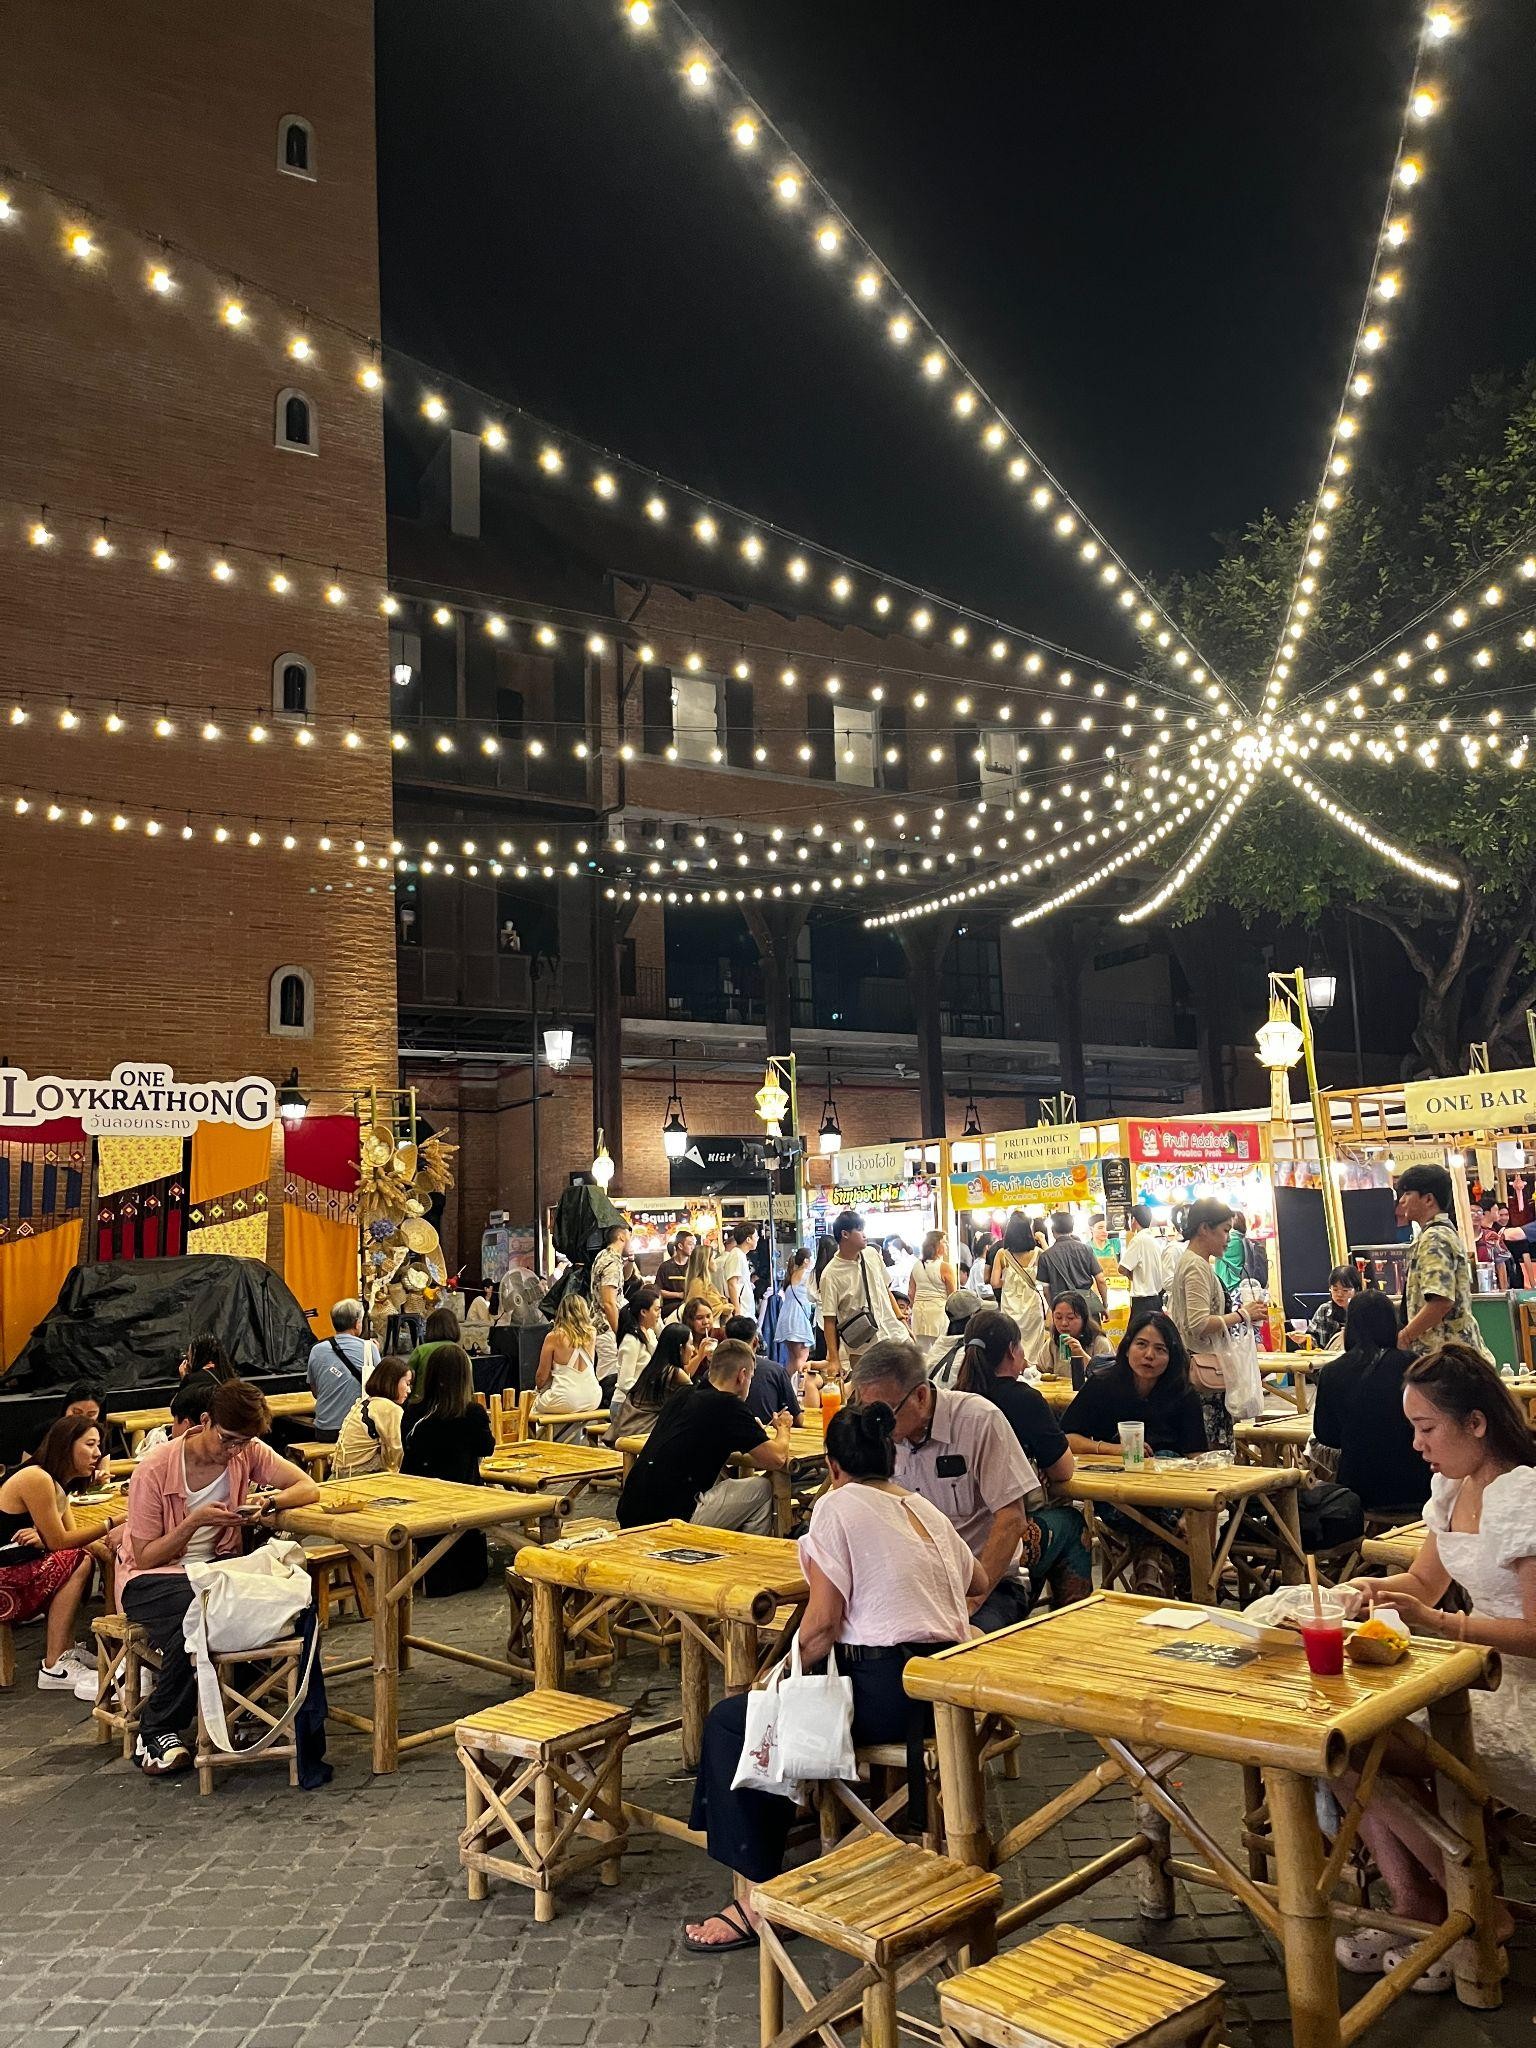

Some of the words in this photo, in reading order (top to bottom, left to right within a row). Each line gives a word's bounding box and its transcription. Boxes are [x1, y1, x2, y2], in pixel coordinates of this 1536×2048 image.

[120, 1070, 165, 1087] ONE
[2, 1076, 268, 1122] LOYKRATHONG
[1426, 1094, 1474, 1114] ONE
[1480, 1088, 1528, 1108] BAR
[90, 1114, 190, 1129] วันลอยกระทง
[1005, 1138, 1029, 1148] FRUIT
[1032, 1133, 1069, 1145] ADDICTS
[1162, 1131, 1189, 1148] Fruit
[1191, 1131, 1230, 1149] Addicts
[1003, 1149, 1043, 1160] PREMIUM
[1046, 1146, 1071, 1156] FRUIT
[991, 1176, 1021, 1192] Fruit
[1024, 1172, 1074, 1190] Addicts
[641, 1211, 677, 1226] Squid
